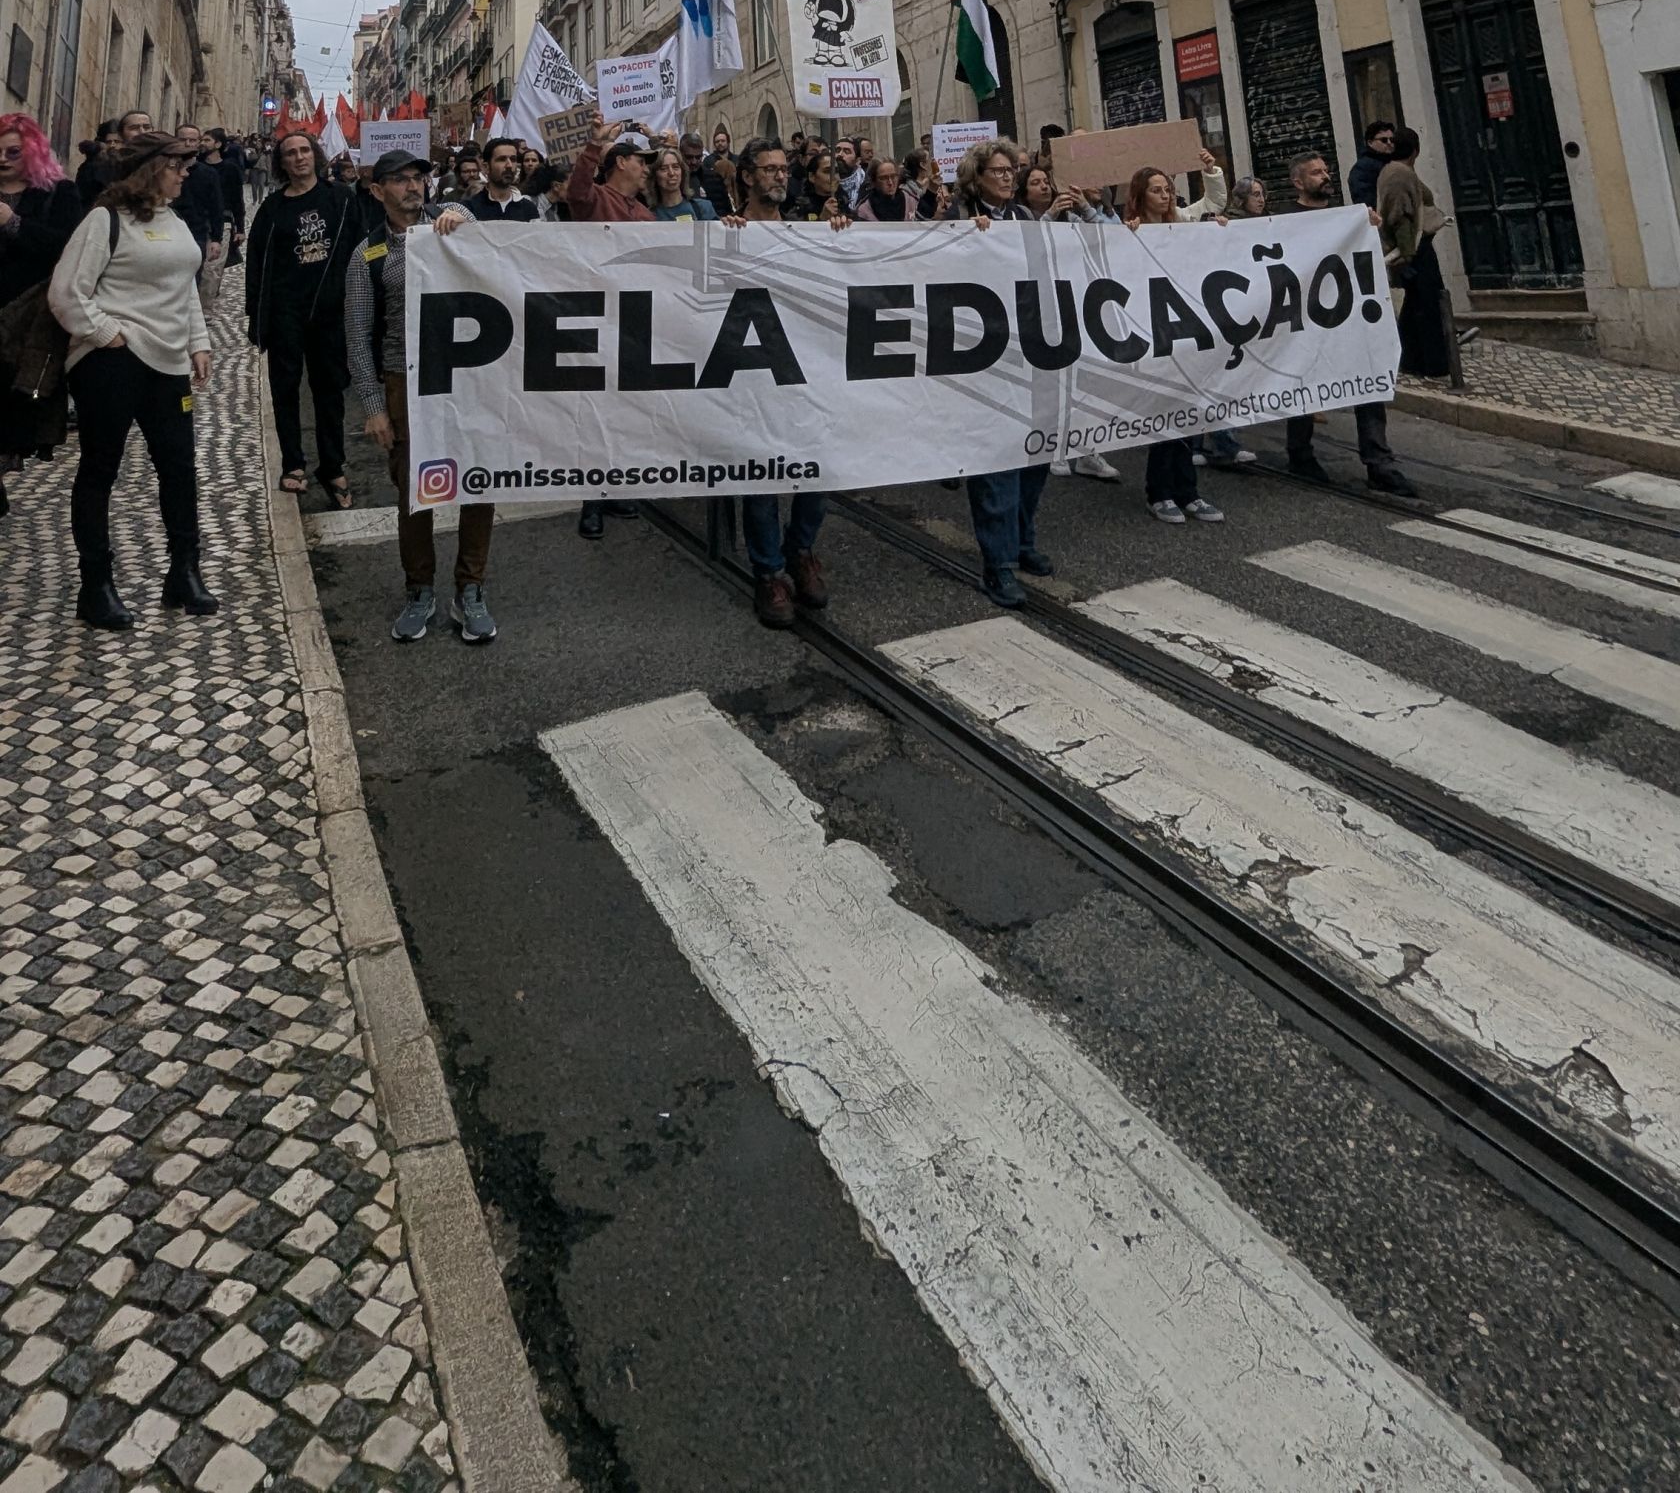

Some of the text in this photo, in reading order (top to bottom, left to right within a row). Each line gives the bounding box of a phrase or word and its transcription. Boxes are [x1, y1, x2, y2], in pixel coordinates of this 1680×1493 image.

[533, 74, 585, 102] E O CAPITAL
[612, 82, 631, 95] NÃO
[632, 81, 654, 92] muito
[831, 80, 881, 99] CONTRA
[612, 94, 656, 109] OBRIGADO!
[838, 99, 858, 108] PACOTE
[858, 99, 882, 108] LABORAL
[397, 132, 422, 141] COUTO
[370, 140, 421, 153] PRESENTE
[300, 212, 319, 225] NO
[296, 219, 327, 237] WAR
[418, 243, 1383, 396] PELA EDUCAÇÃO!
[1024, 369, 1396, 456] Os professores constroem pontes!
[462, 455, 820, 495] @missaoescolapublica
